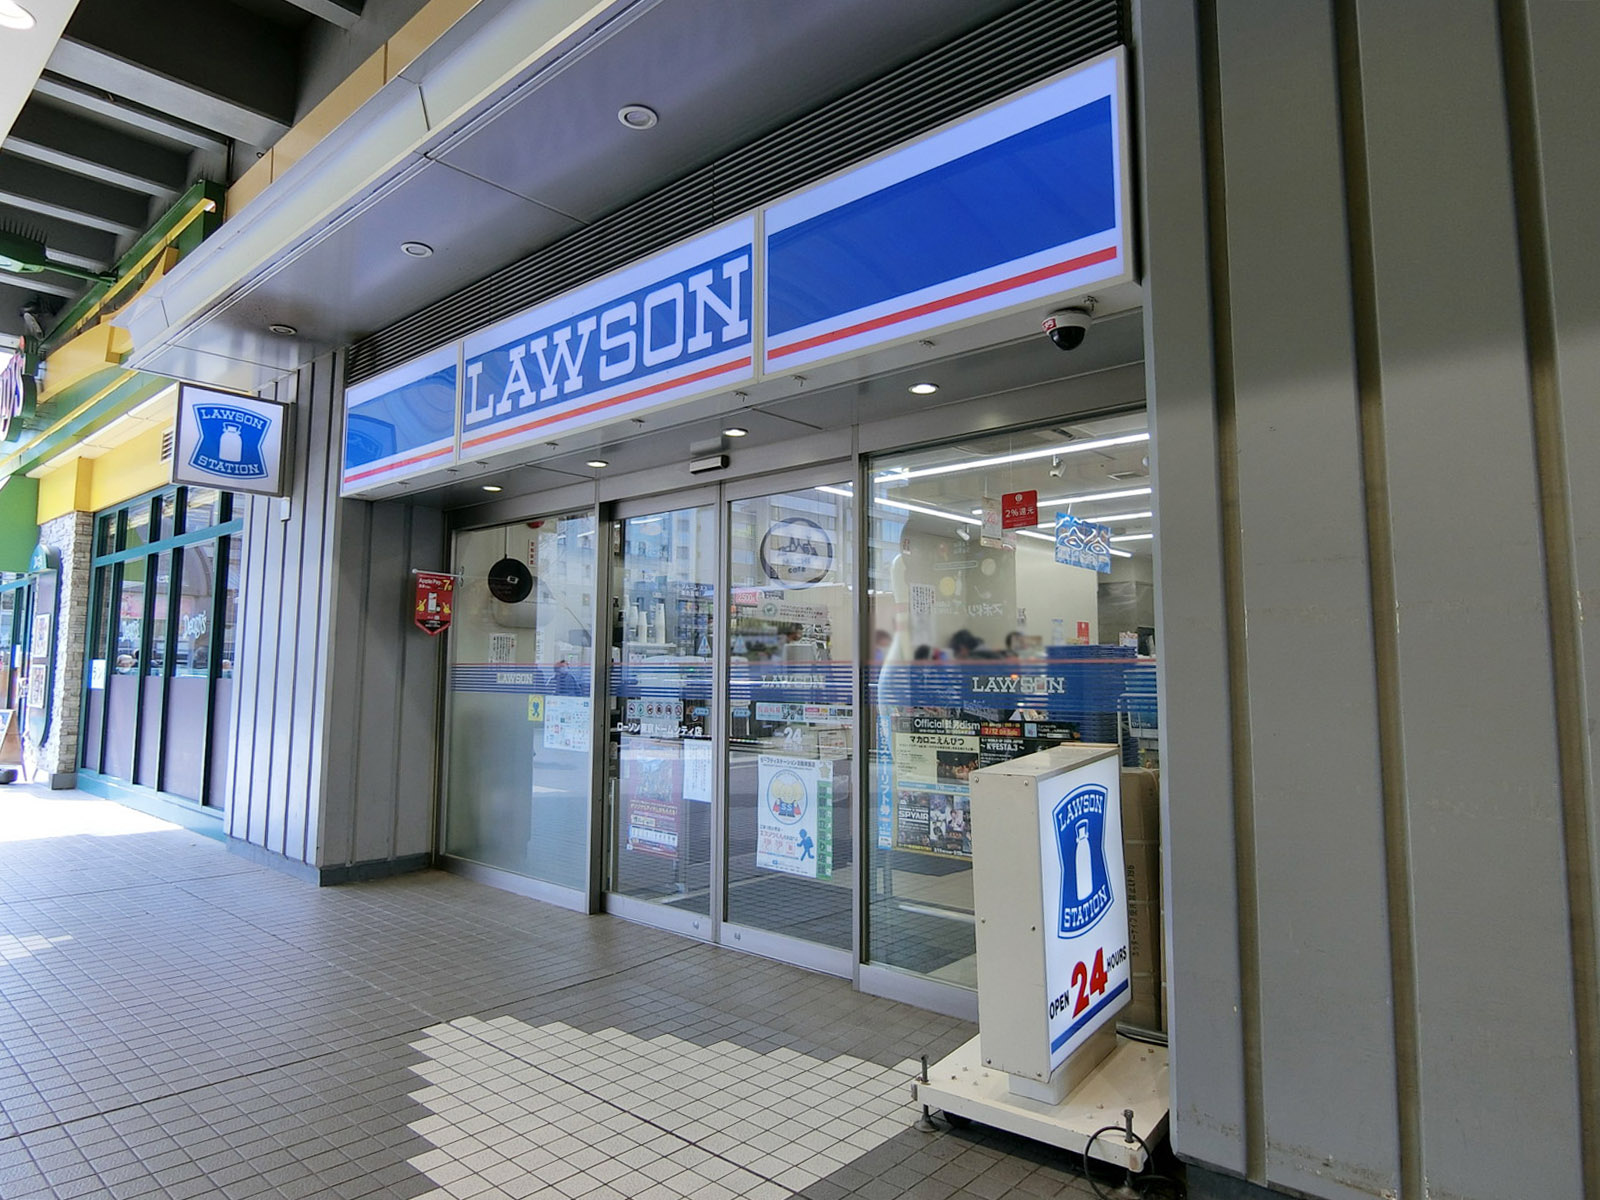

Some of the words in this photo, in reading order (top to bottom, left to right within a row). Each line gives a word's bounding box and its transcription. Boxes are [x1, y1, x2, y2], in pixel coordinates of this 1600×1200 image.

[465, 254, 749, 426] LAWSON
[200, 408, 265, 430] LAWSON
[197, 456, 260, 475] STATION
[497, 672, 533, 684] LAWSON
[972, 676, 1065, 694] LAWSON
[899, 810, 929, 820] SPYAIR
[1058, 795, 1103, 832] LAWSON
[1063, 884, 1108, 928] STATION
[1049, 992, 1070, 1020] OPEN
[1072, 946, 1108, 1019] 24
[1107, 945, 1128, 974] HOURS
